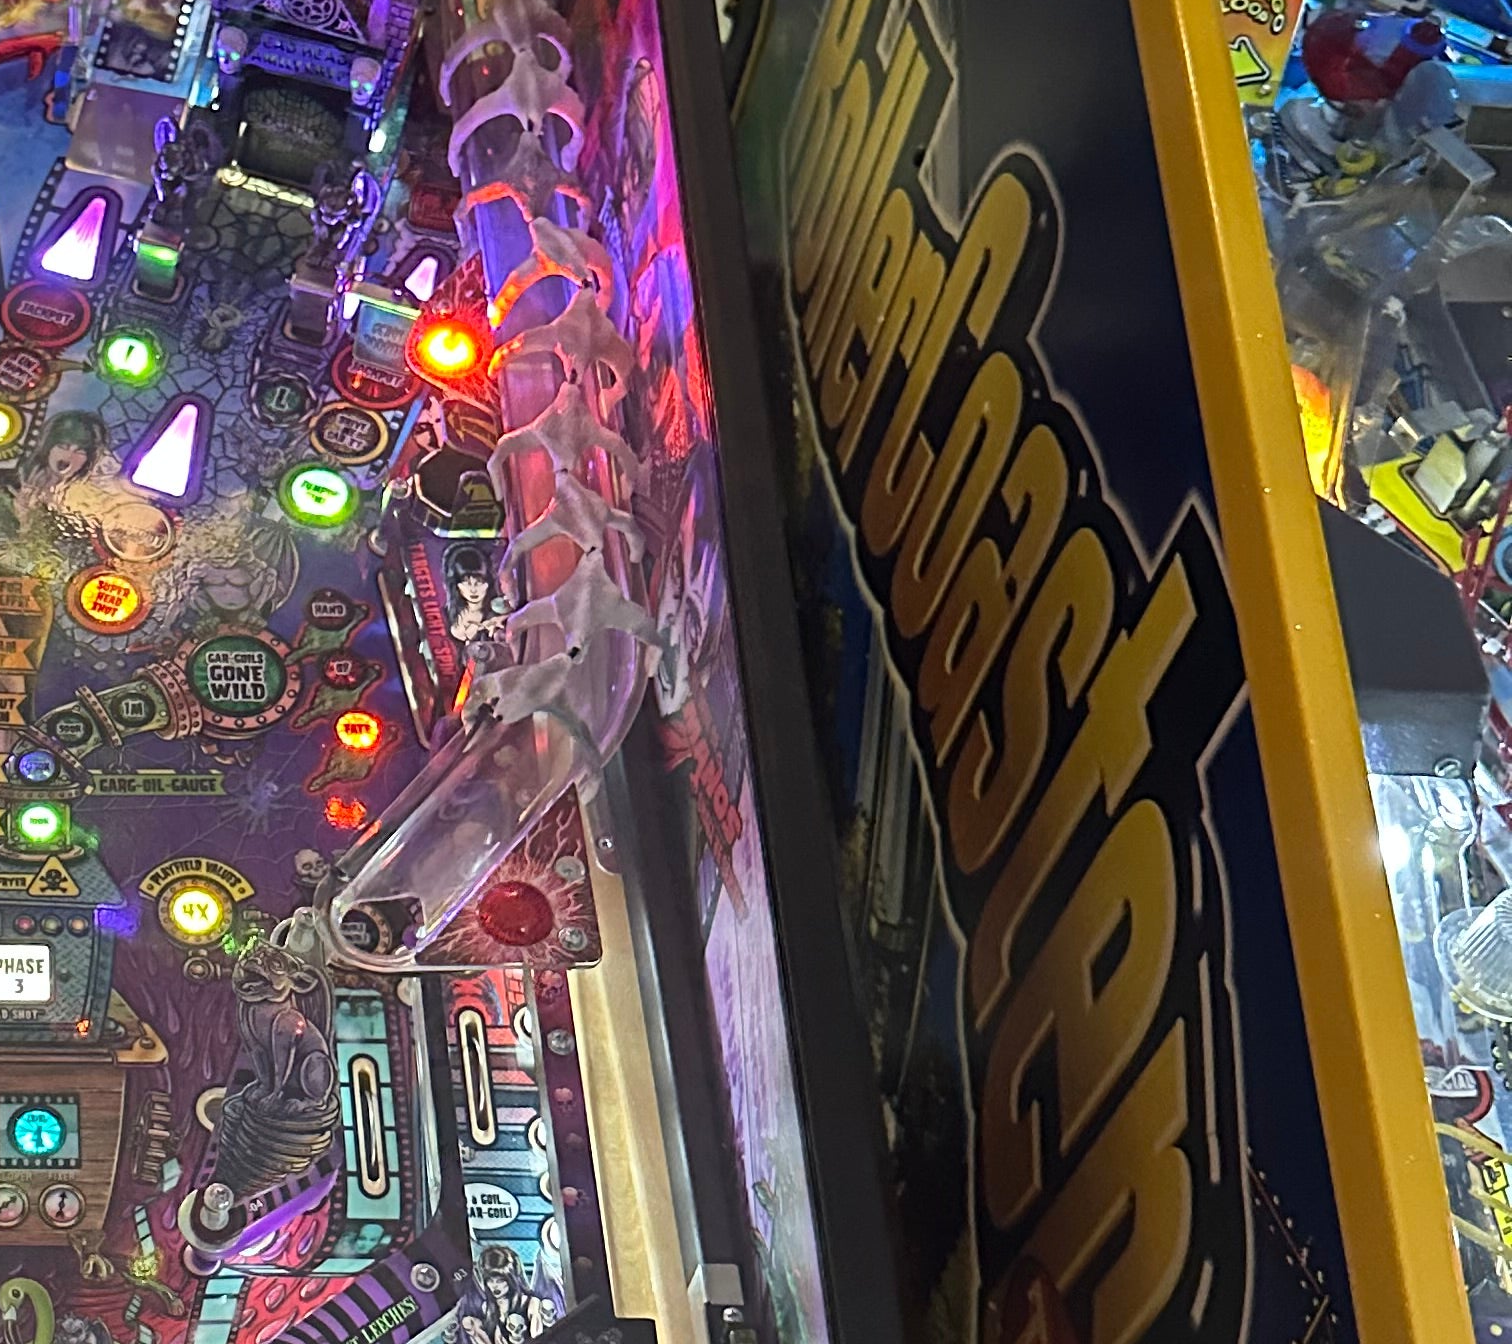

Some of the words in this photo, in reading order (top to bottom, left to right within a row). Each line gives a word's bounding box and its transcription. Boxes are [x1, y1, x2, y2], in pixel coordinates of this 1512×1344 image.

[17, 301, 75, 326] JACKPOT
[97, 580, 131, 597] SUPER
[410, 543, 434, 600] TARGETS
[424, 596, 445, 632] LIGHT
[96, 592, 123, 607] HEAD
[312, 601, 346, 618] HAND
[208, 664, 265, 683] GONE
[209, 681, 267, 702] WILD
[122, 700, 145, 718] 1M
[99, 778, 217, 794] GARG-OIL-GAUGE
[151, 859, 202, 888] PLAYFIELD
[200, 858, 244, 888] VALUES
[182, 903, 210, 921] 4X
[13, 978, 25, 994] 3
[361, 1295, 421, 1344] LEECHES!
